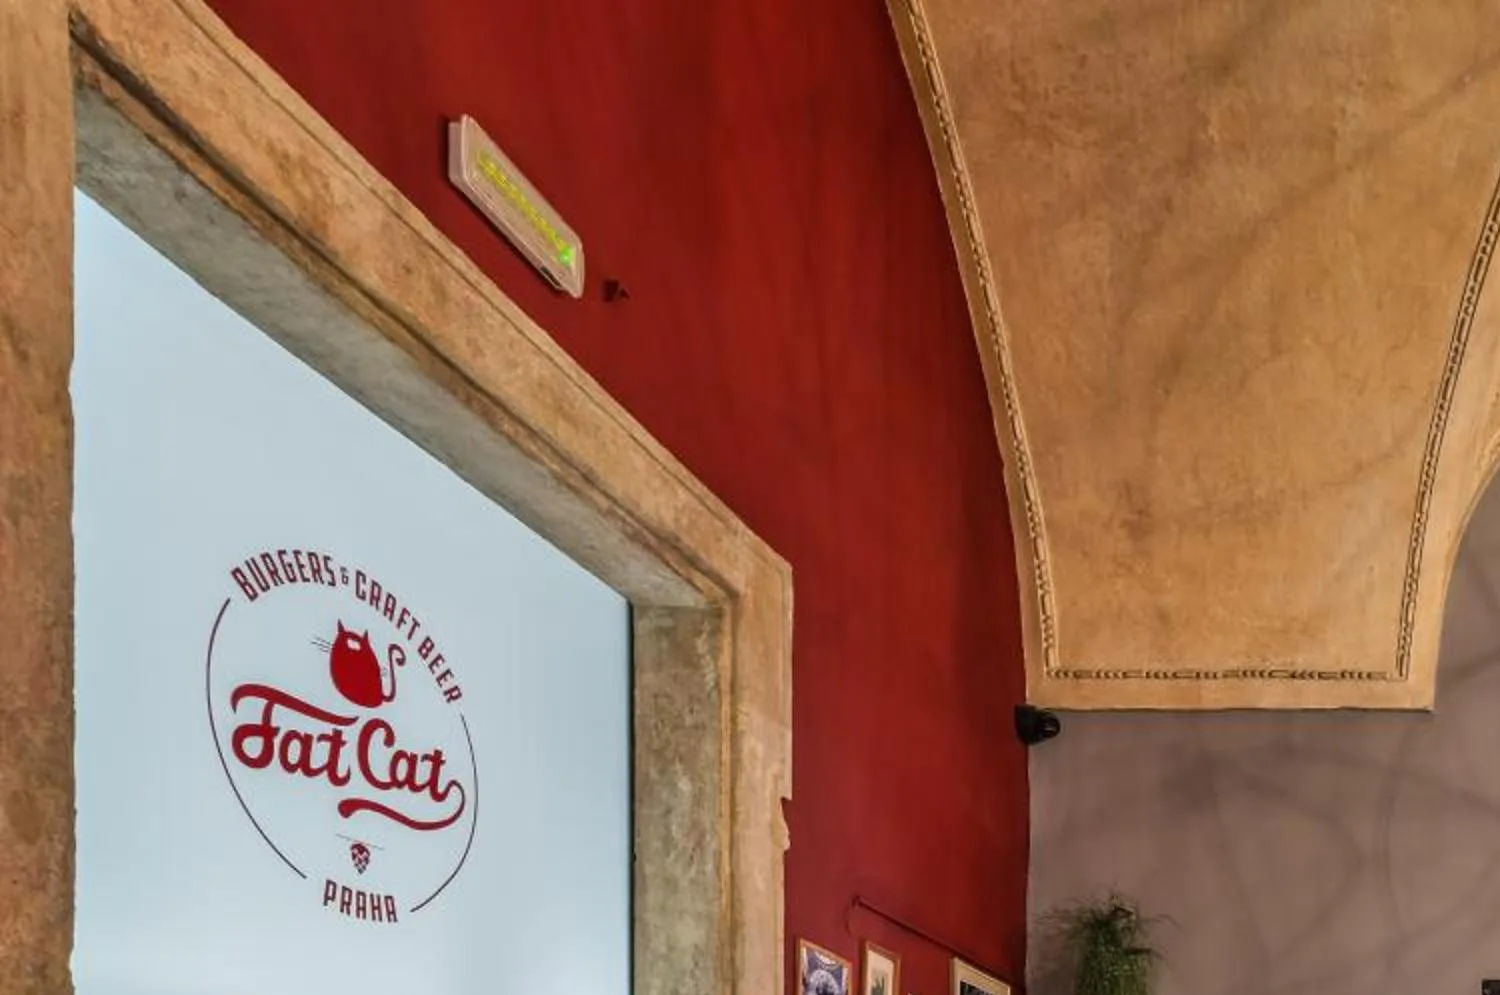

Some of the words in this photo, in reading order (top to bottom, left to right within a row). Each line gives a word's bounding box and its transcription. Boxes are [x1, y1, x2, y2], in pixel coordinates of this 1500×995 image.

[230, 549, 336, 601] BURGERS
[355, 570, 421, 641] CRAFT
[417, 635, 463, 703] BEER
[231, 683, 360, 787] Fat
[345, 718, 466, 831] Cat
[323, 879, 399, 923] PRAHA
